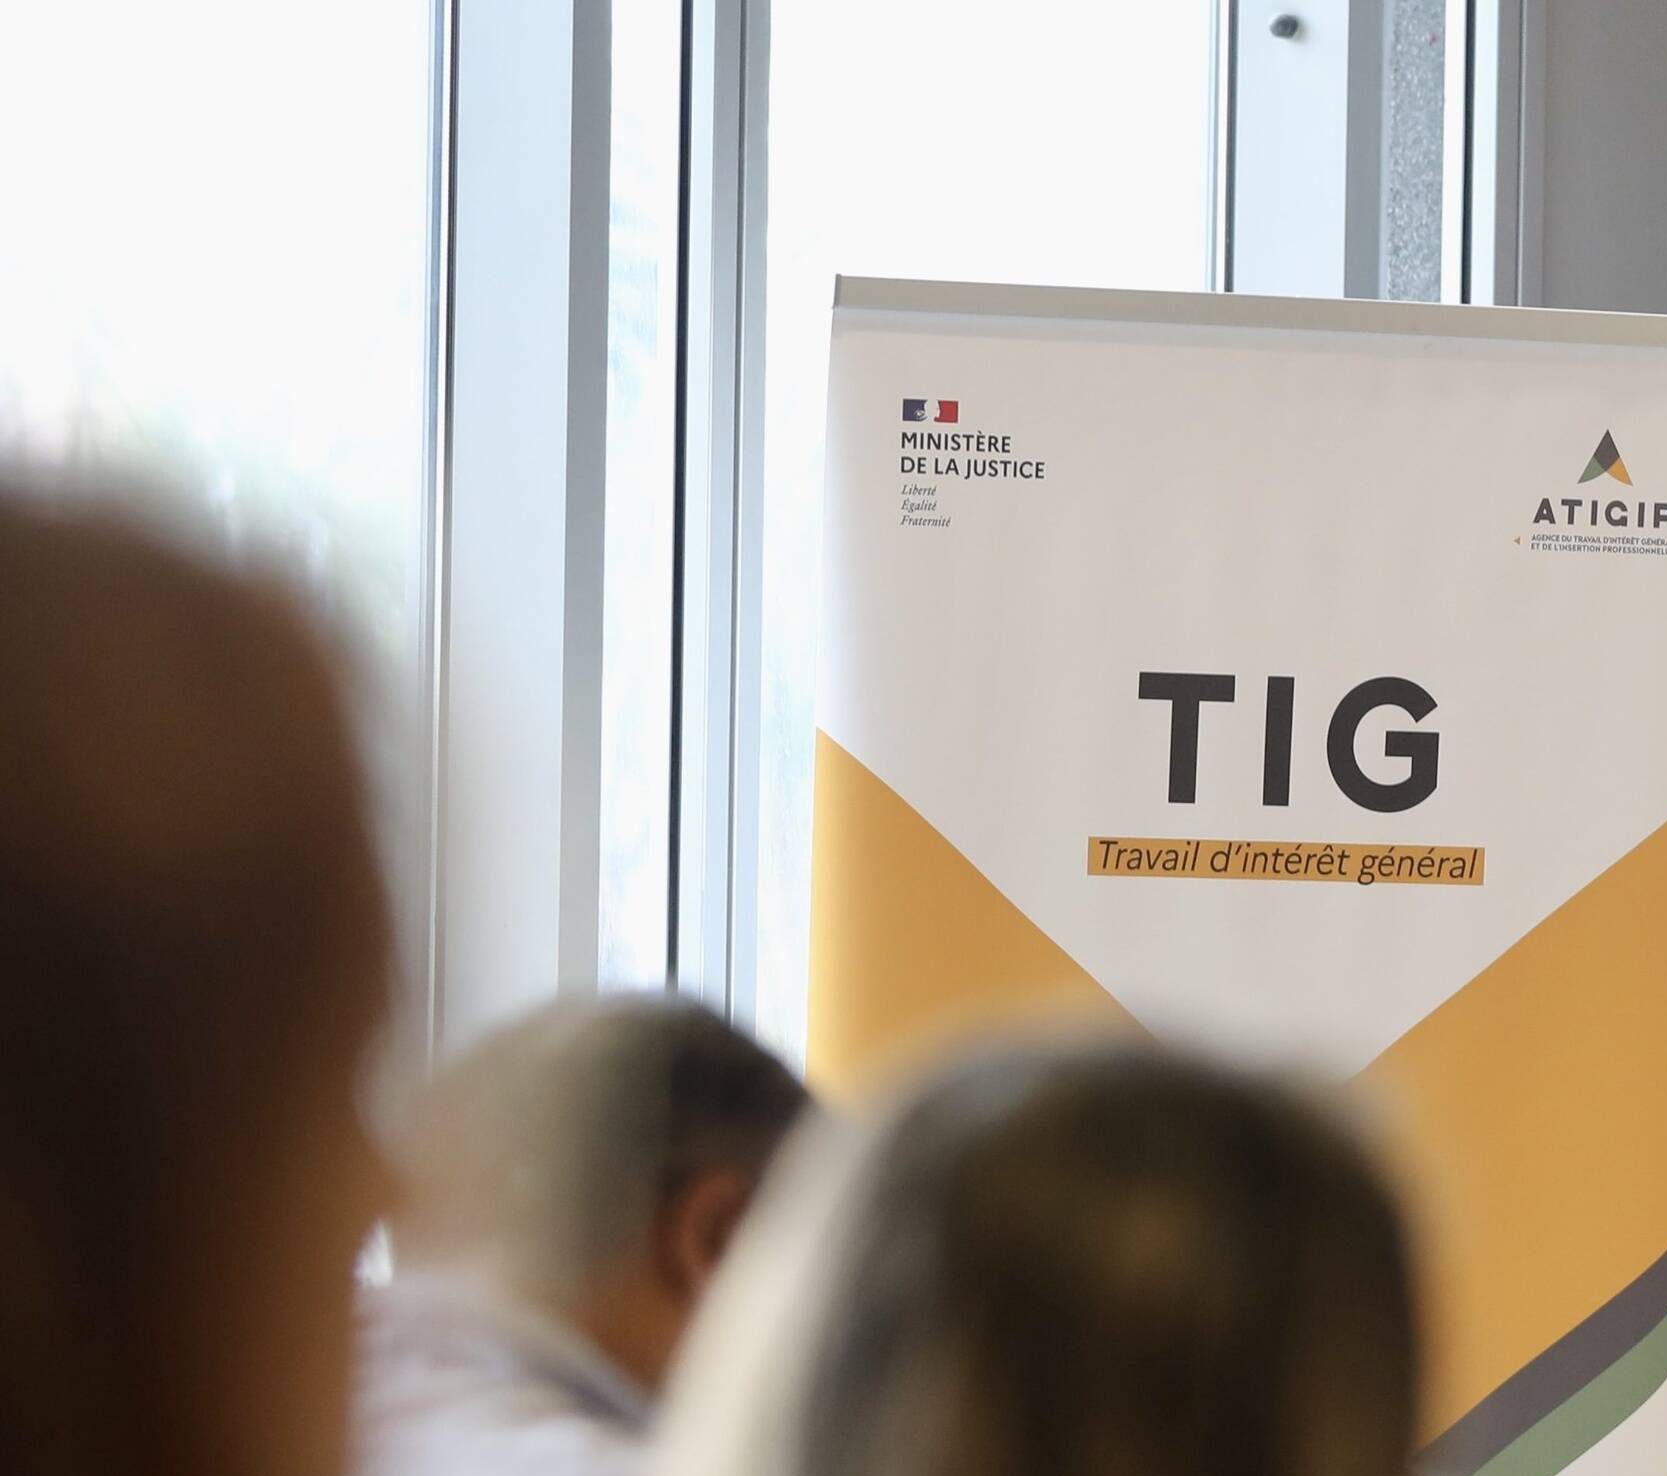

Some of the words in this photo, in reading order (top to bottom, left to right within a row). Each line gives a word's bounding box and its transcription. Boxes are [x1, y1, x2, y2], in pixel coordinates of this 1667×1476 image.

[900, 431, 1011, 453] MINISTÈRE
[900, 456, 927, 474] DE
[934, 457, 959, 476] LA
[964, 459, 1045, 480] JUSTICE
[901, 484, 937, 496] Liberté
[900, 498, 937, 513] Égalité
[900, 515, 951, 527] Fraternité
[1531, 534, 1560, 542] AGENCE
[1561, 534, 1573, 543] DU
[1573, 535, 1601, 544] TRAVAIL
[1530, 543, 1540, 551] ET
[1542, 543, 1552, 551] DE
[1138, 671, 1441, 814] TIG
[1099, 840, 1200, 872] Travail
[1209, 842, 1350, 876] d'intérêt
[1357, 846, 1478, 886] général
